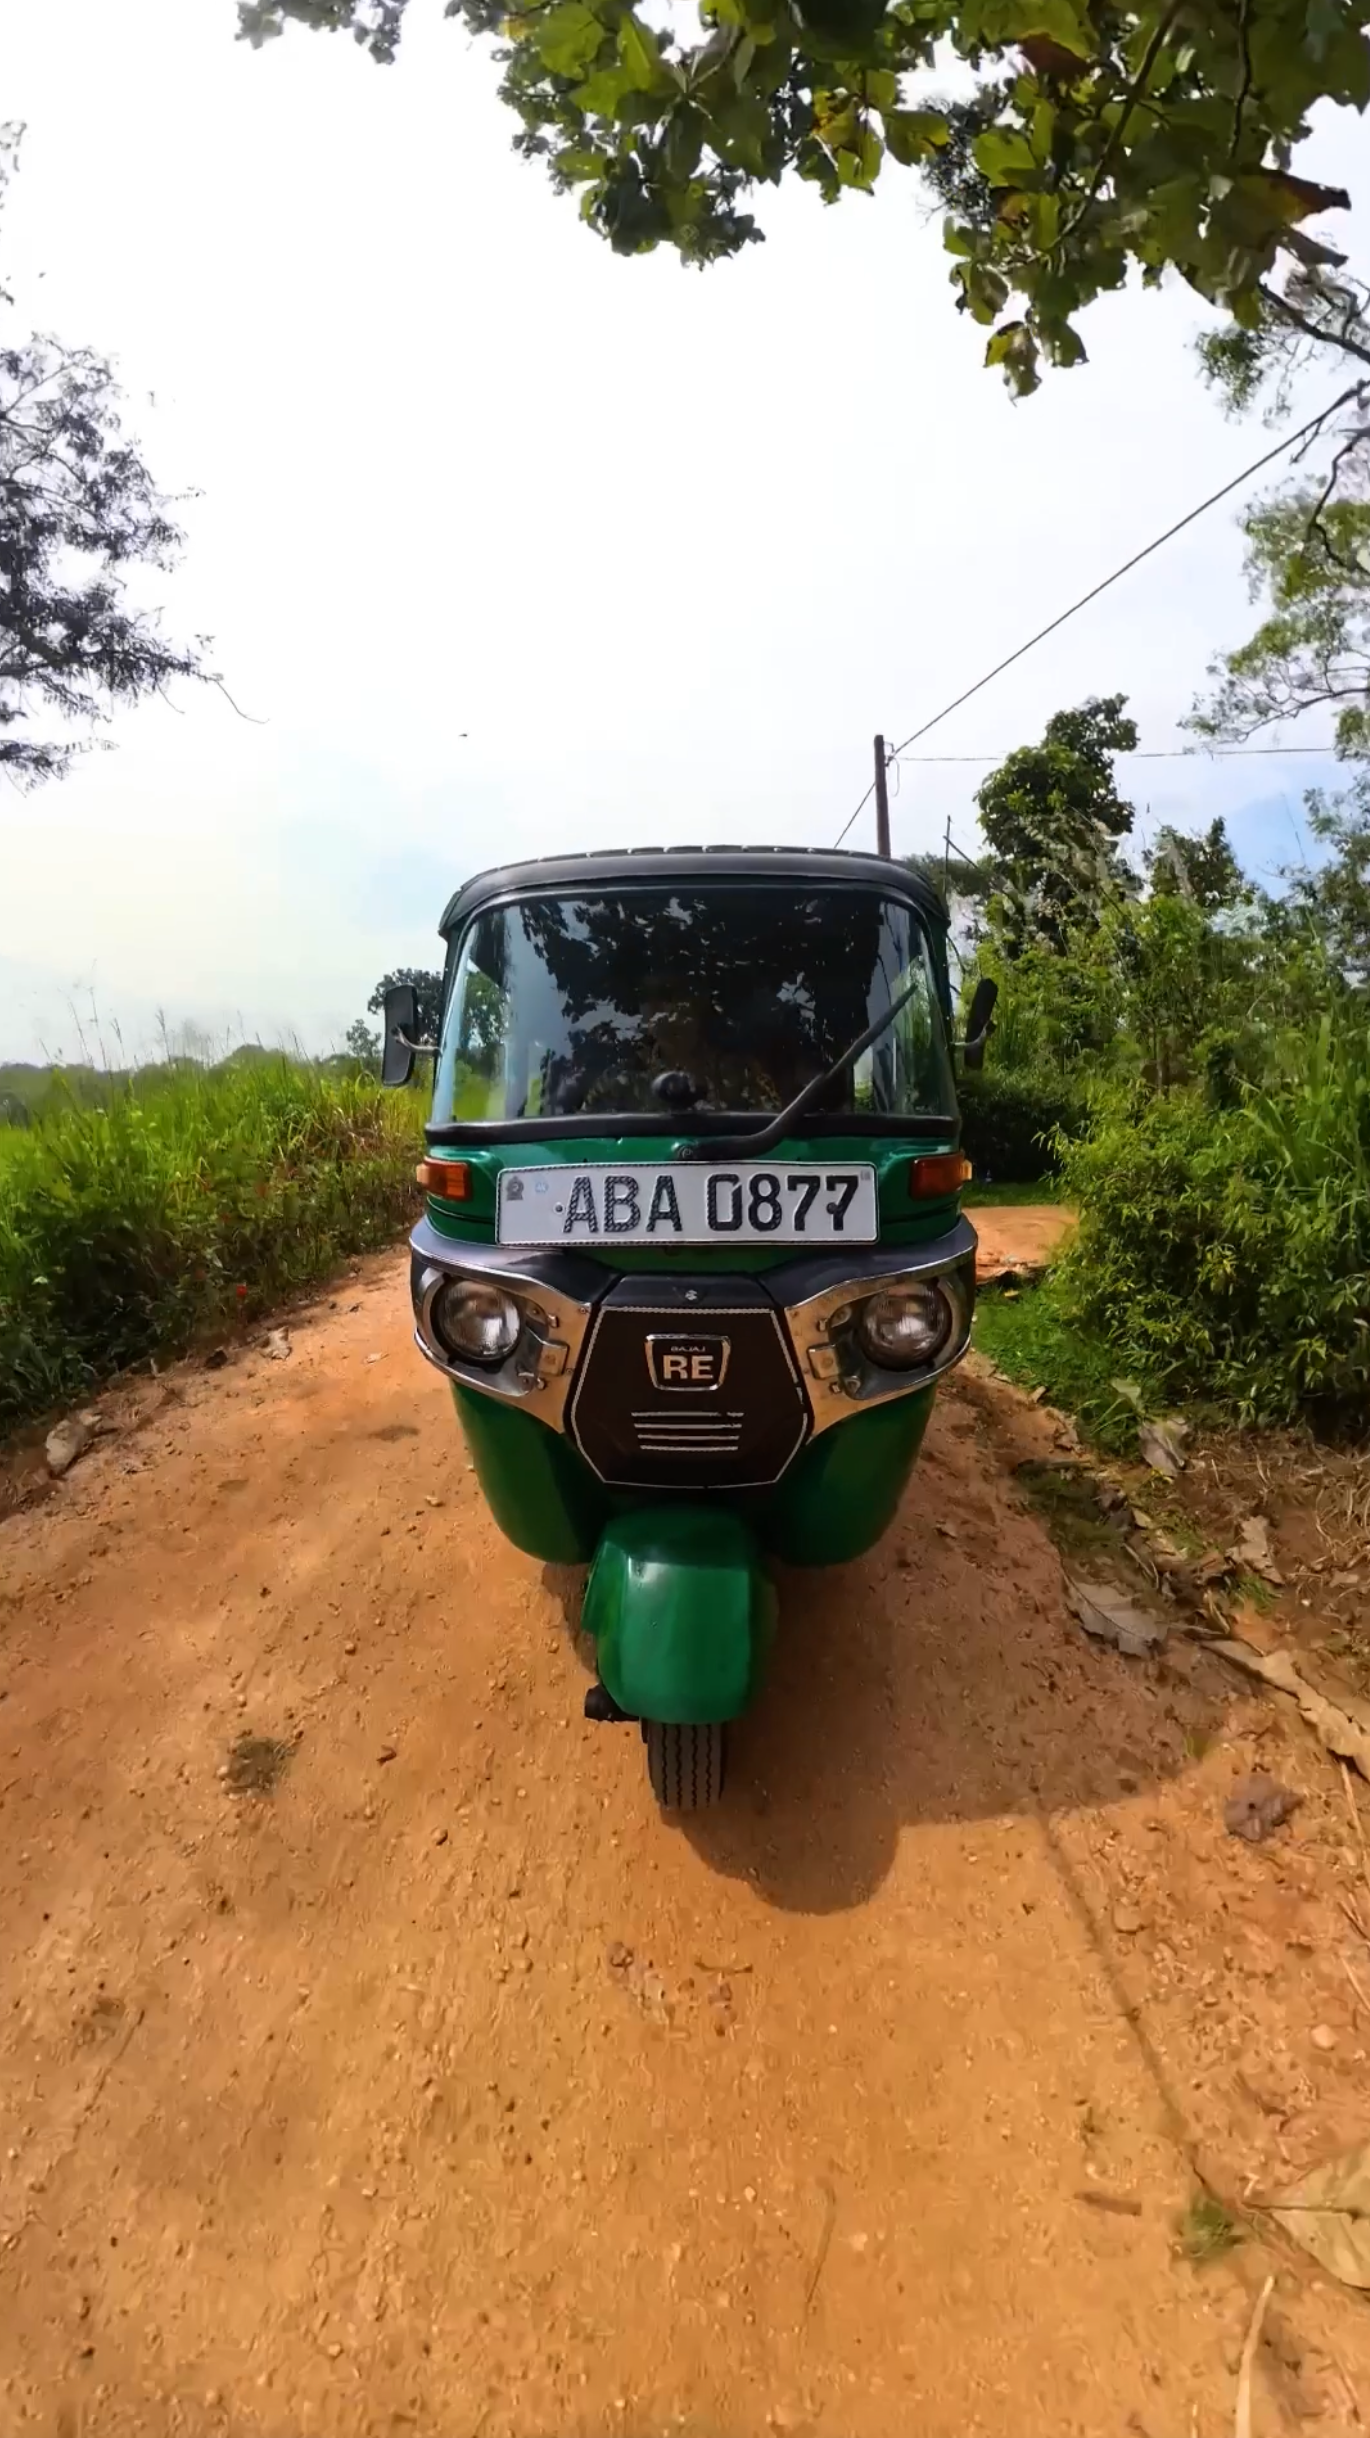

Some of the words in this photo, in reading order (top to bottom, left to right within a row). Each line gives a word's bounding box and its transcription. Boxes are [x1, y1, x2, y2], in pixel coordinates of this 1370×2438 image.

[563, 1174, 682, 1233] ABA
[706, 1173, 860, 1231] 0877
[663, 1355, 714, 1379] RE
